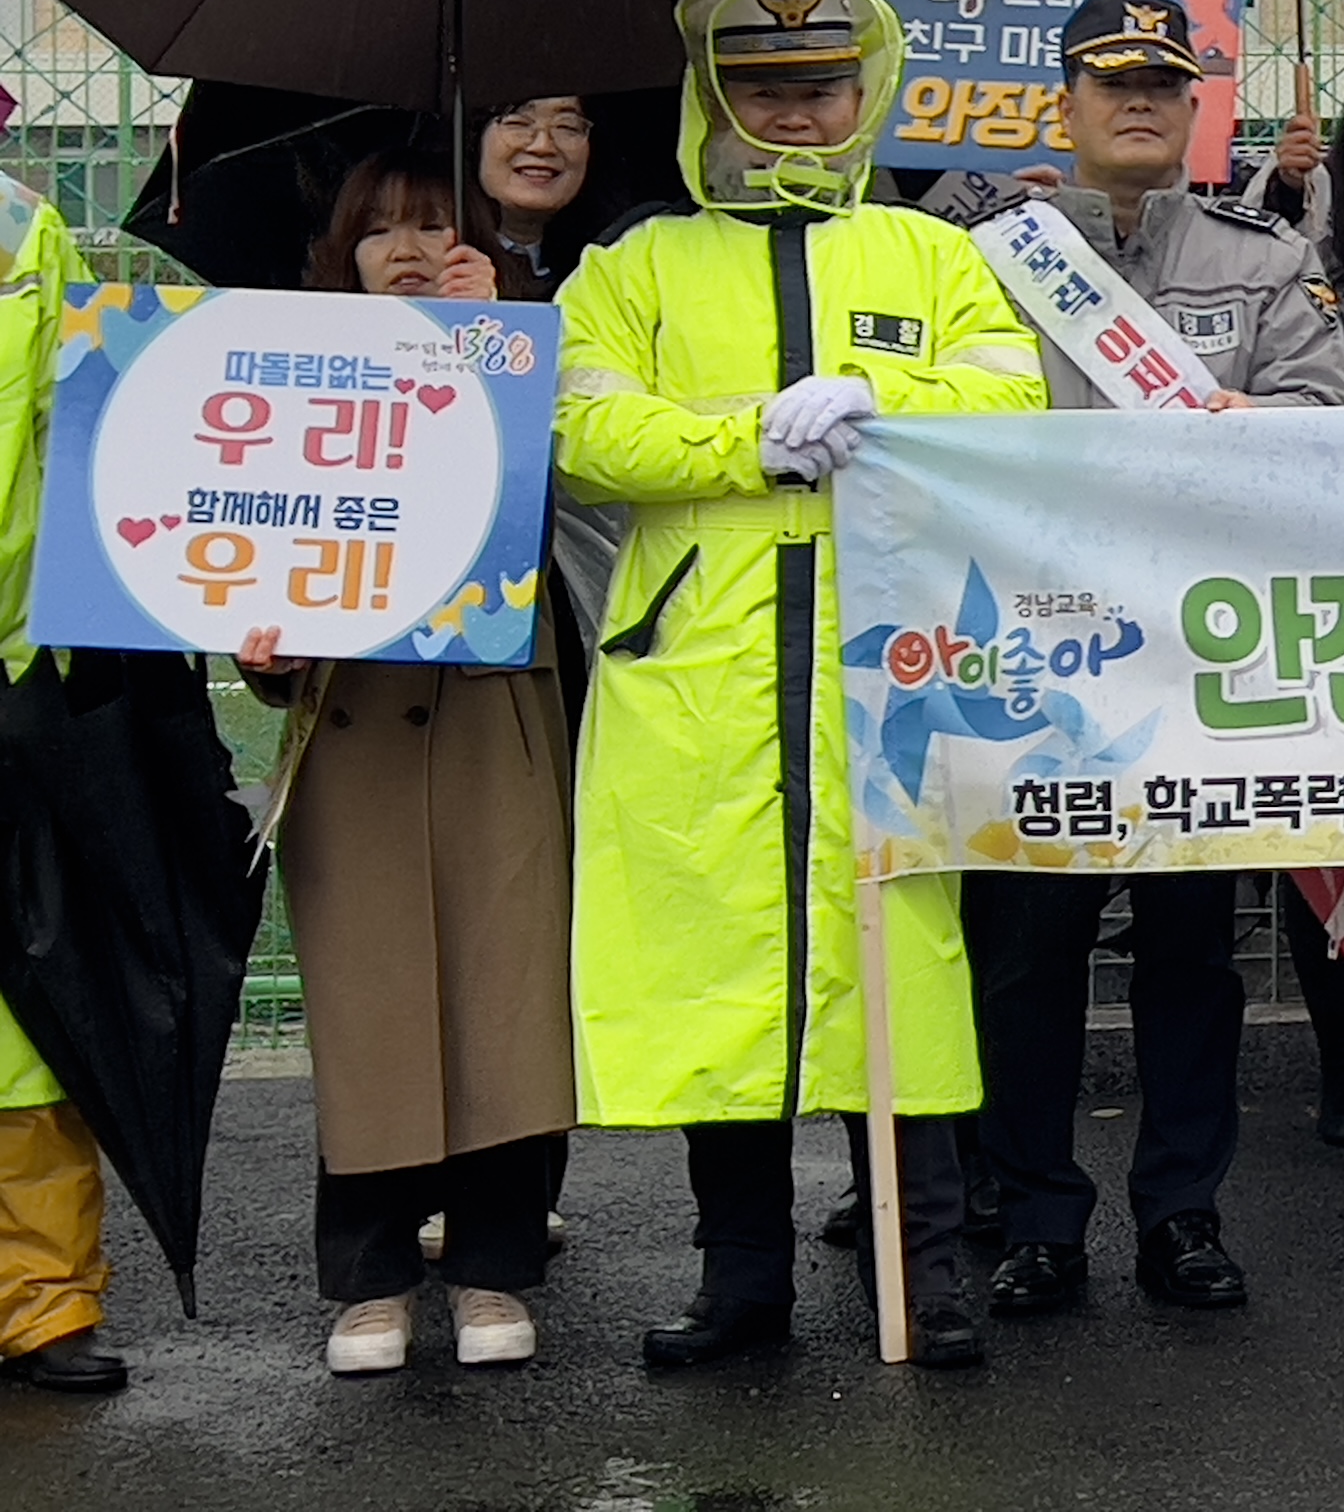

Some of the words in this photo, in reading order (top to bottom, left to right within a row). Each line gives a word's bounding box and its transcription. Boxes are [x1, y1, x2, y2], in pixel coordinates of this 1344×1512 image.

[903, 19, 986, 64] 친구
[994, 209, 1103, 317] 교폭력
[225, 350, 394, 391] 따돌림없는
[186, 488, 321, 530] 함께해서
[333, 497, 400, 533] 좋은
[1014, 592, 1097, 618] 경남교육
[888, 617, 1146, 715] 아이좋아
[1012, 777, 1129, 840] 청렴,
